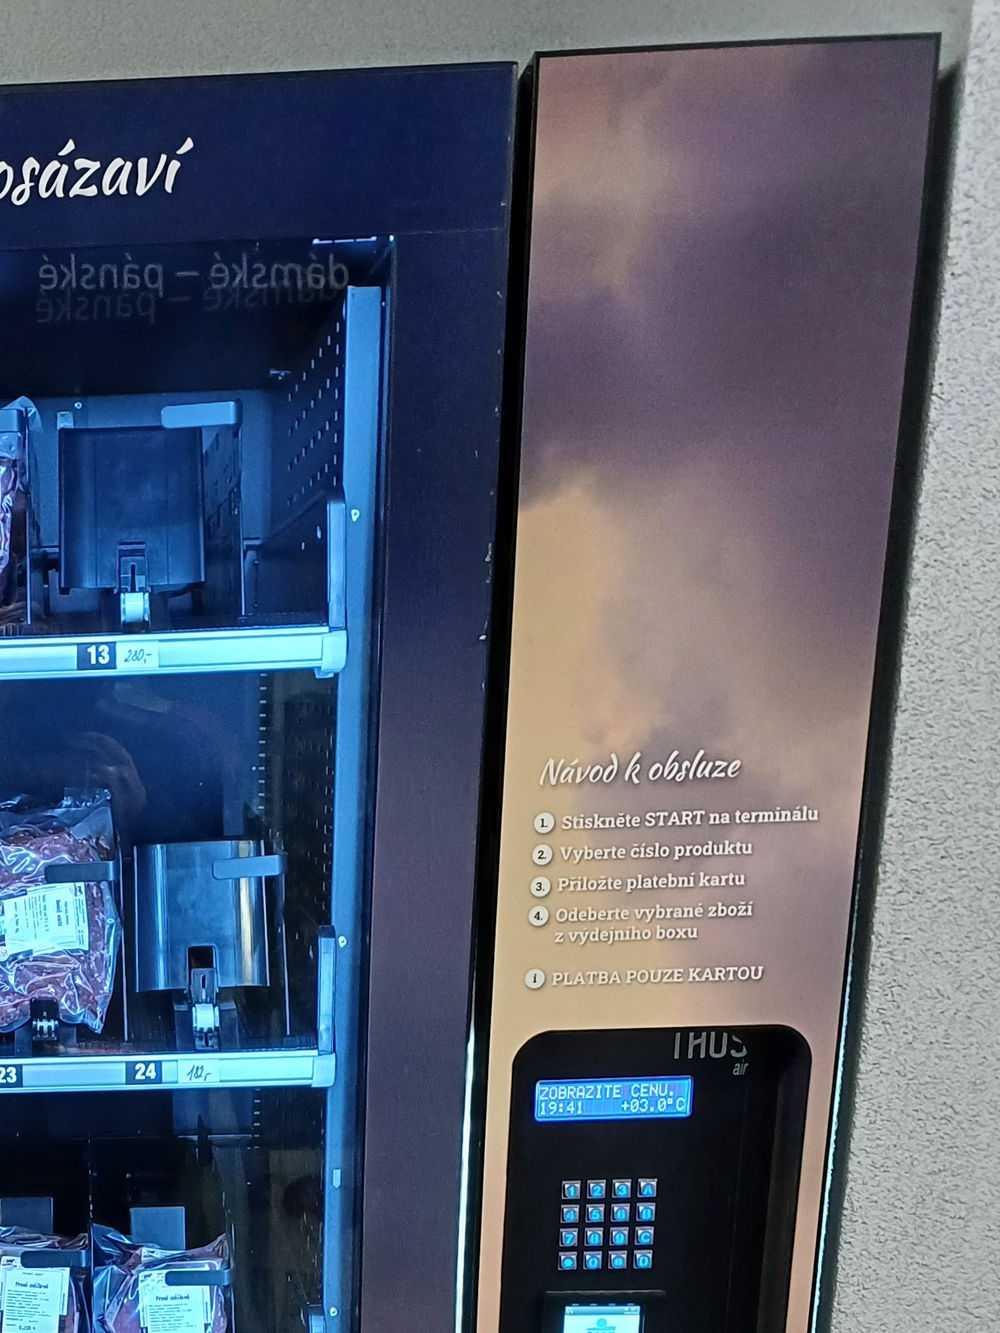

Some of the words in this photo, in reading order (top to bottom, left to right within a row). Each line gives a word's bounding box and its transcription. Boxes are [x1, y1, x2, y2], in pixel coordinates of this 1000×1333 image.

[87, 645, 110, 665] 13
[539, 753, 619, 786] Návod
[624, 751, 642, 785] k
[648, 750, 741, 782] obsluze
[561, 812, 641, 829] Stiskněte
[645, 810, 706, 827] START
[709, 812, 730, 825] na
[735, 806, 819, 824] terminálu
[560, 846, 626, 865] Vyberte
[631, 842, 670, 860] číslo
[673, 840, 753, 861] produktu
[558, 875, 622, 892] Přiložte
[626, 872, 695, 893] platební
[699, 872, 746, 887] kartu
[556, 907, 629, 923] Odeberte
[634, 902, 703, 923] vybrané
[708, 901, 754, 918] zboží
[554, 933, 564, 943] z
[568, 926, 652, 946] výdejního
[656, 925, 698, 941] boxu
[552, 971, 621, 986] PLATBA
[625, 968, 684, 983] POUZE
[688, 966, 764, 982] KARTOU
[135, 1063, 156, 1080] 24
[732, 1060, 749, 1076] air
[540, 1084, 622, 1101] ZOBRAZITE
[540, 1101, 583, 1115] 19:41
